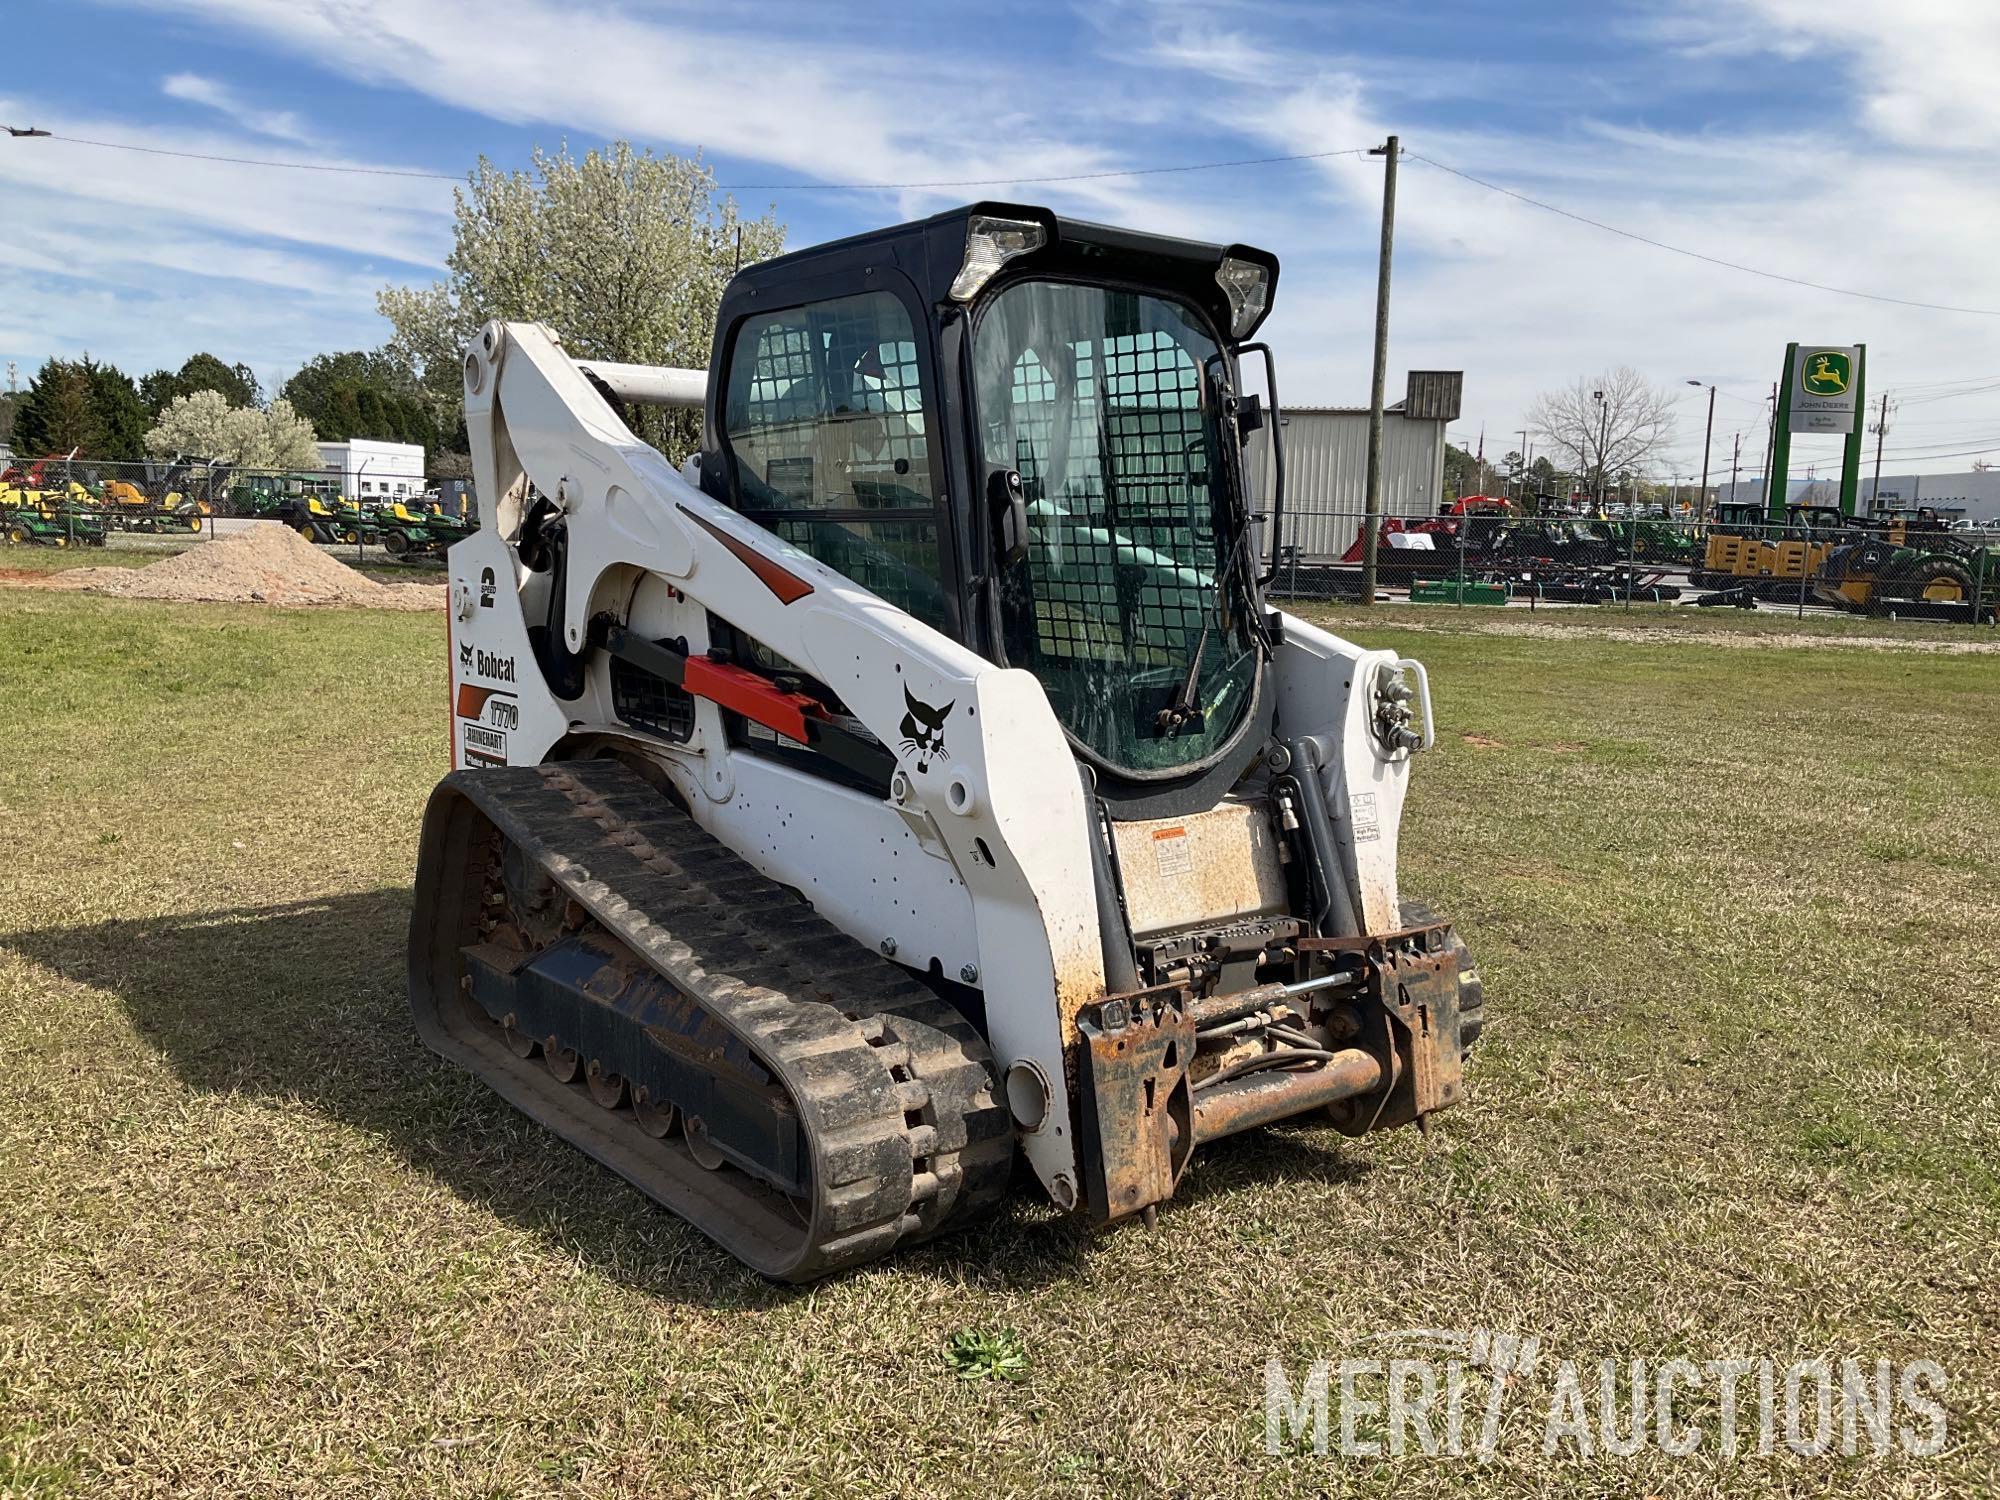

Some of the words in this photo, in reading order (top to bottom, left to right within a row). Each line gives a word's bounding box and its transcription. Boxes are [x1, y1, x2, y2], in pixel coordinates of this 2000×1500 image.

[1798, 401, 1821, 409] JOHN
[1822, 401, 1849, 409] DEERE
[480, 584, 497, 594] SPEED
[477, 650, 515, 683] Bobcat
[491, 700, 518, 730] T770
[466, 727, 503, 750] RHINEHART
